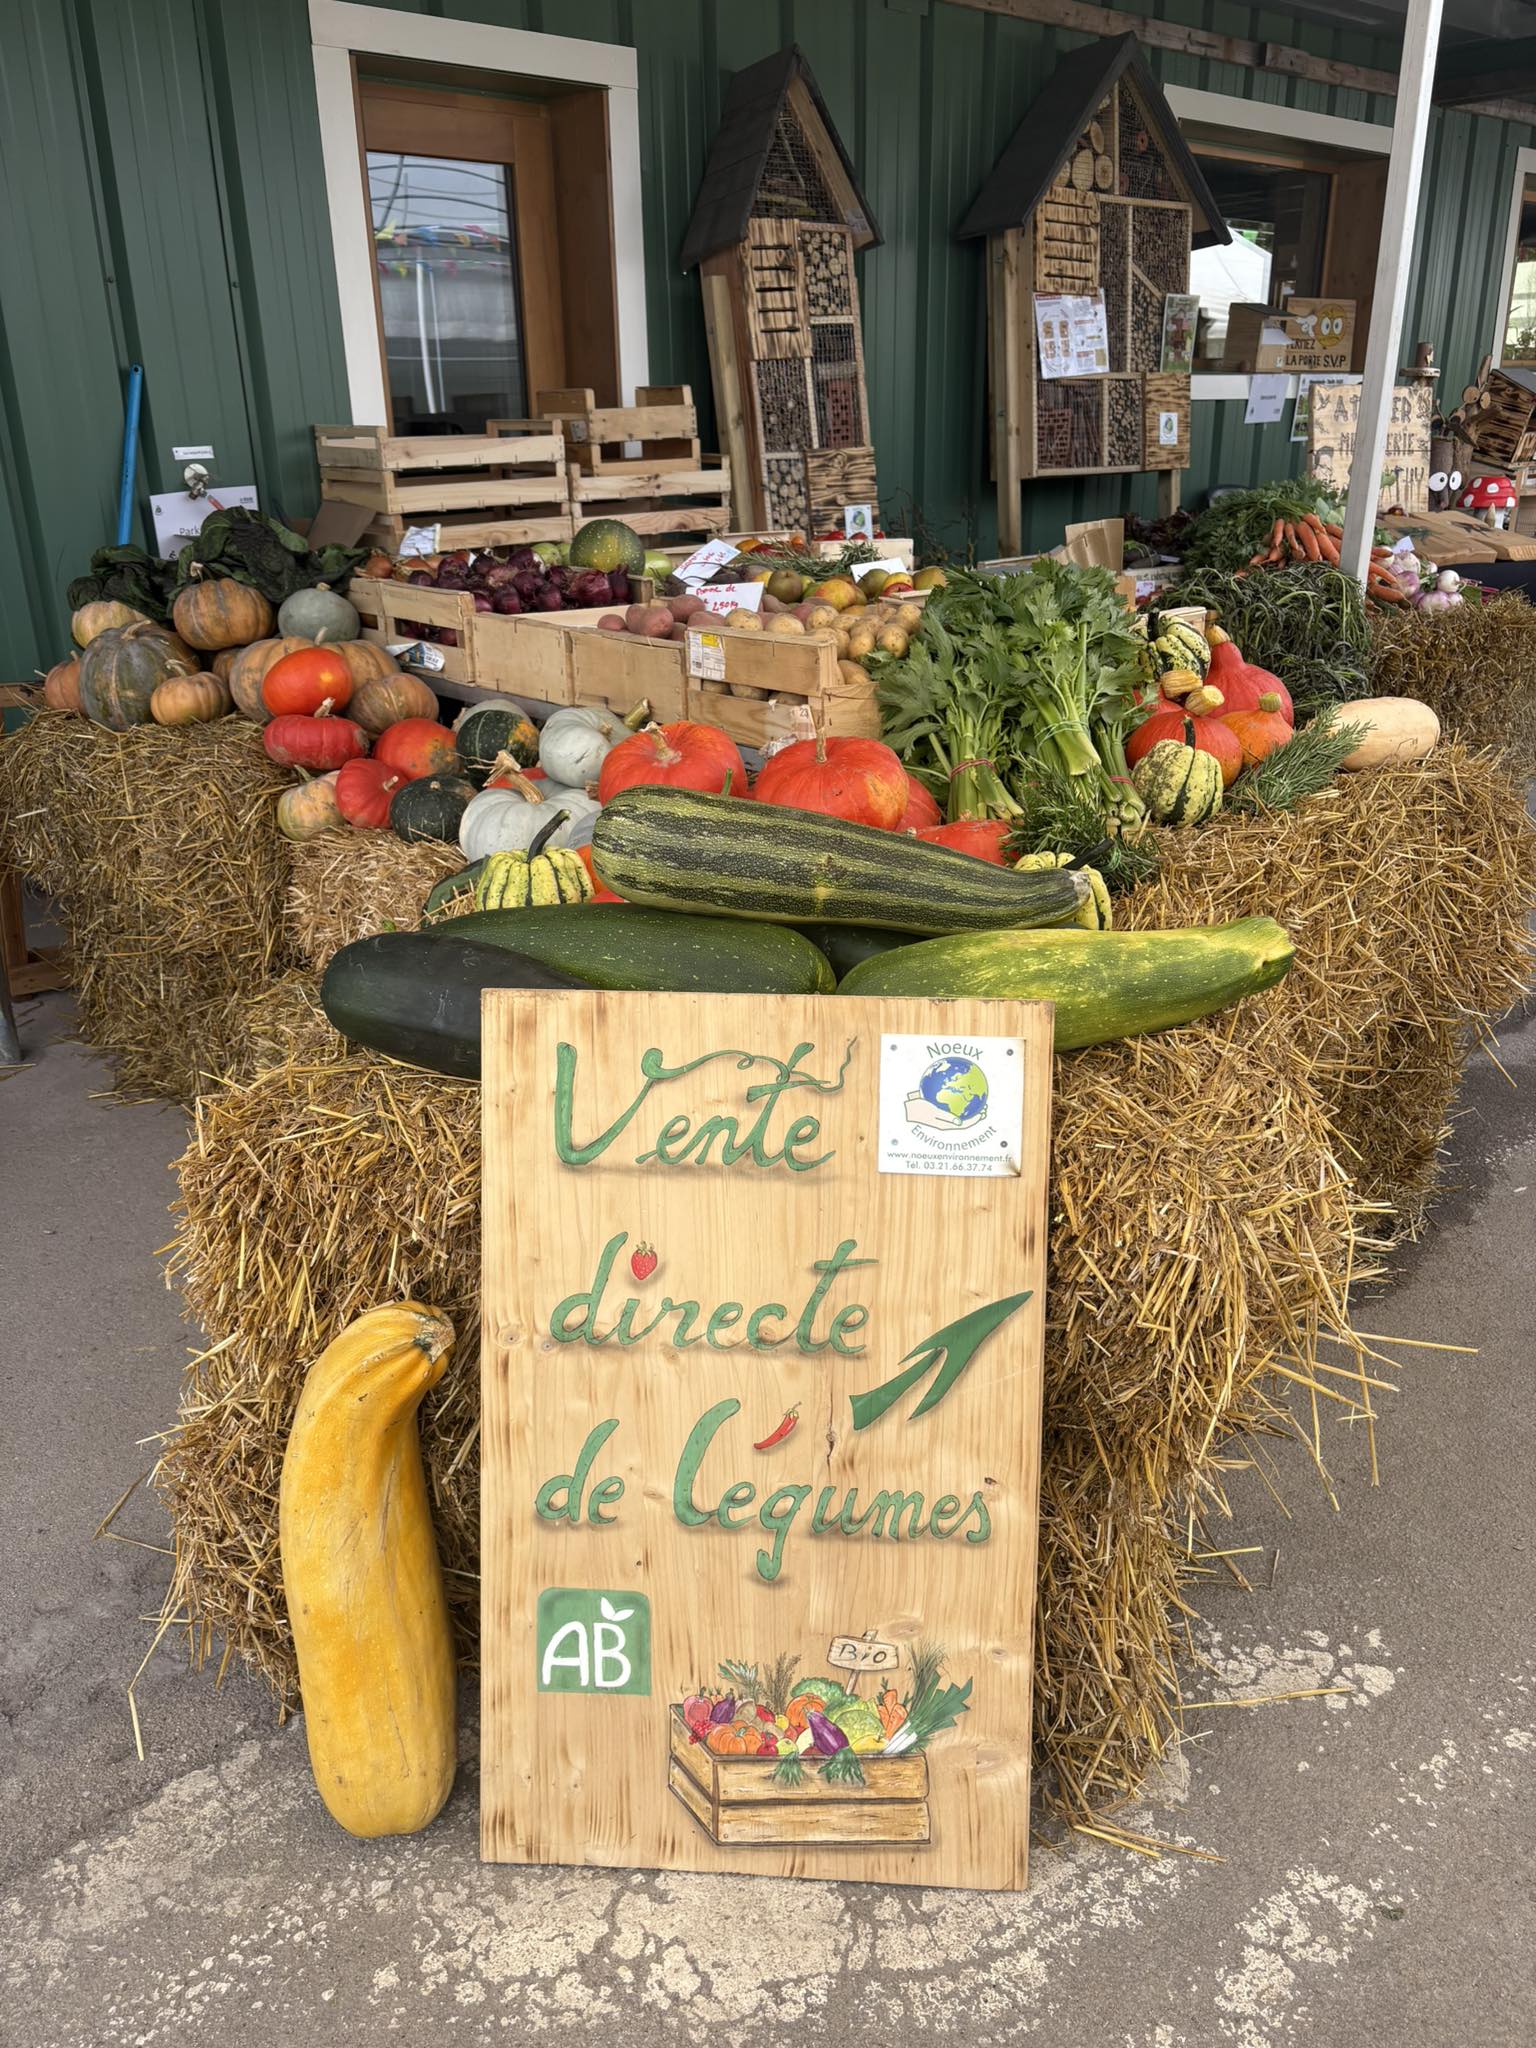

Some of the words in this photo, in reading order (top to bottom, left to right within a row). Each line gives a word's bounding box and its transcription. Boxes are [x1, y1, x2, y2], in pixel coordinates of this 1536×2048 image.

[1285, 354, 1297, 366] LA
[1298, 354, 1321, 368] PORTE
[1333, 394, 1412, 424] ATER
[179, 525, 201, 536] Park
[725, 583, 737, 592] de
[926, 1042, 983, 1060] Noeux
[553, 1036, 857, 1172] Vente
[911, 1124, 997, 1151] Environnement
[887, 1151, 1012, 1163] www.noeuxenvironnement.fr
[924, 1161, 992, 1172] 03.21.66.37.74
[550, 1231, 880, 1356] directe
[535, 1418, 625, 1525] de
[540, 1620, 632, 1689] AB
